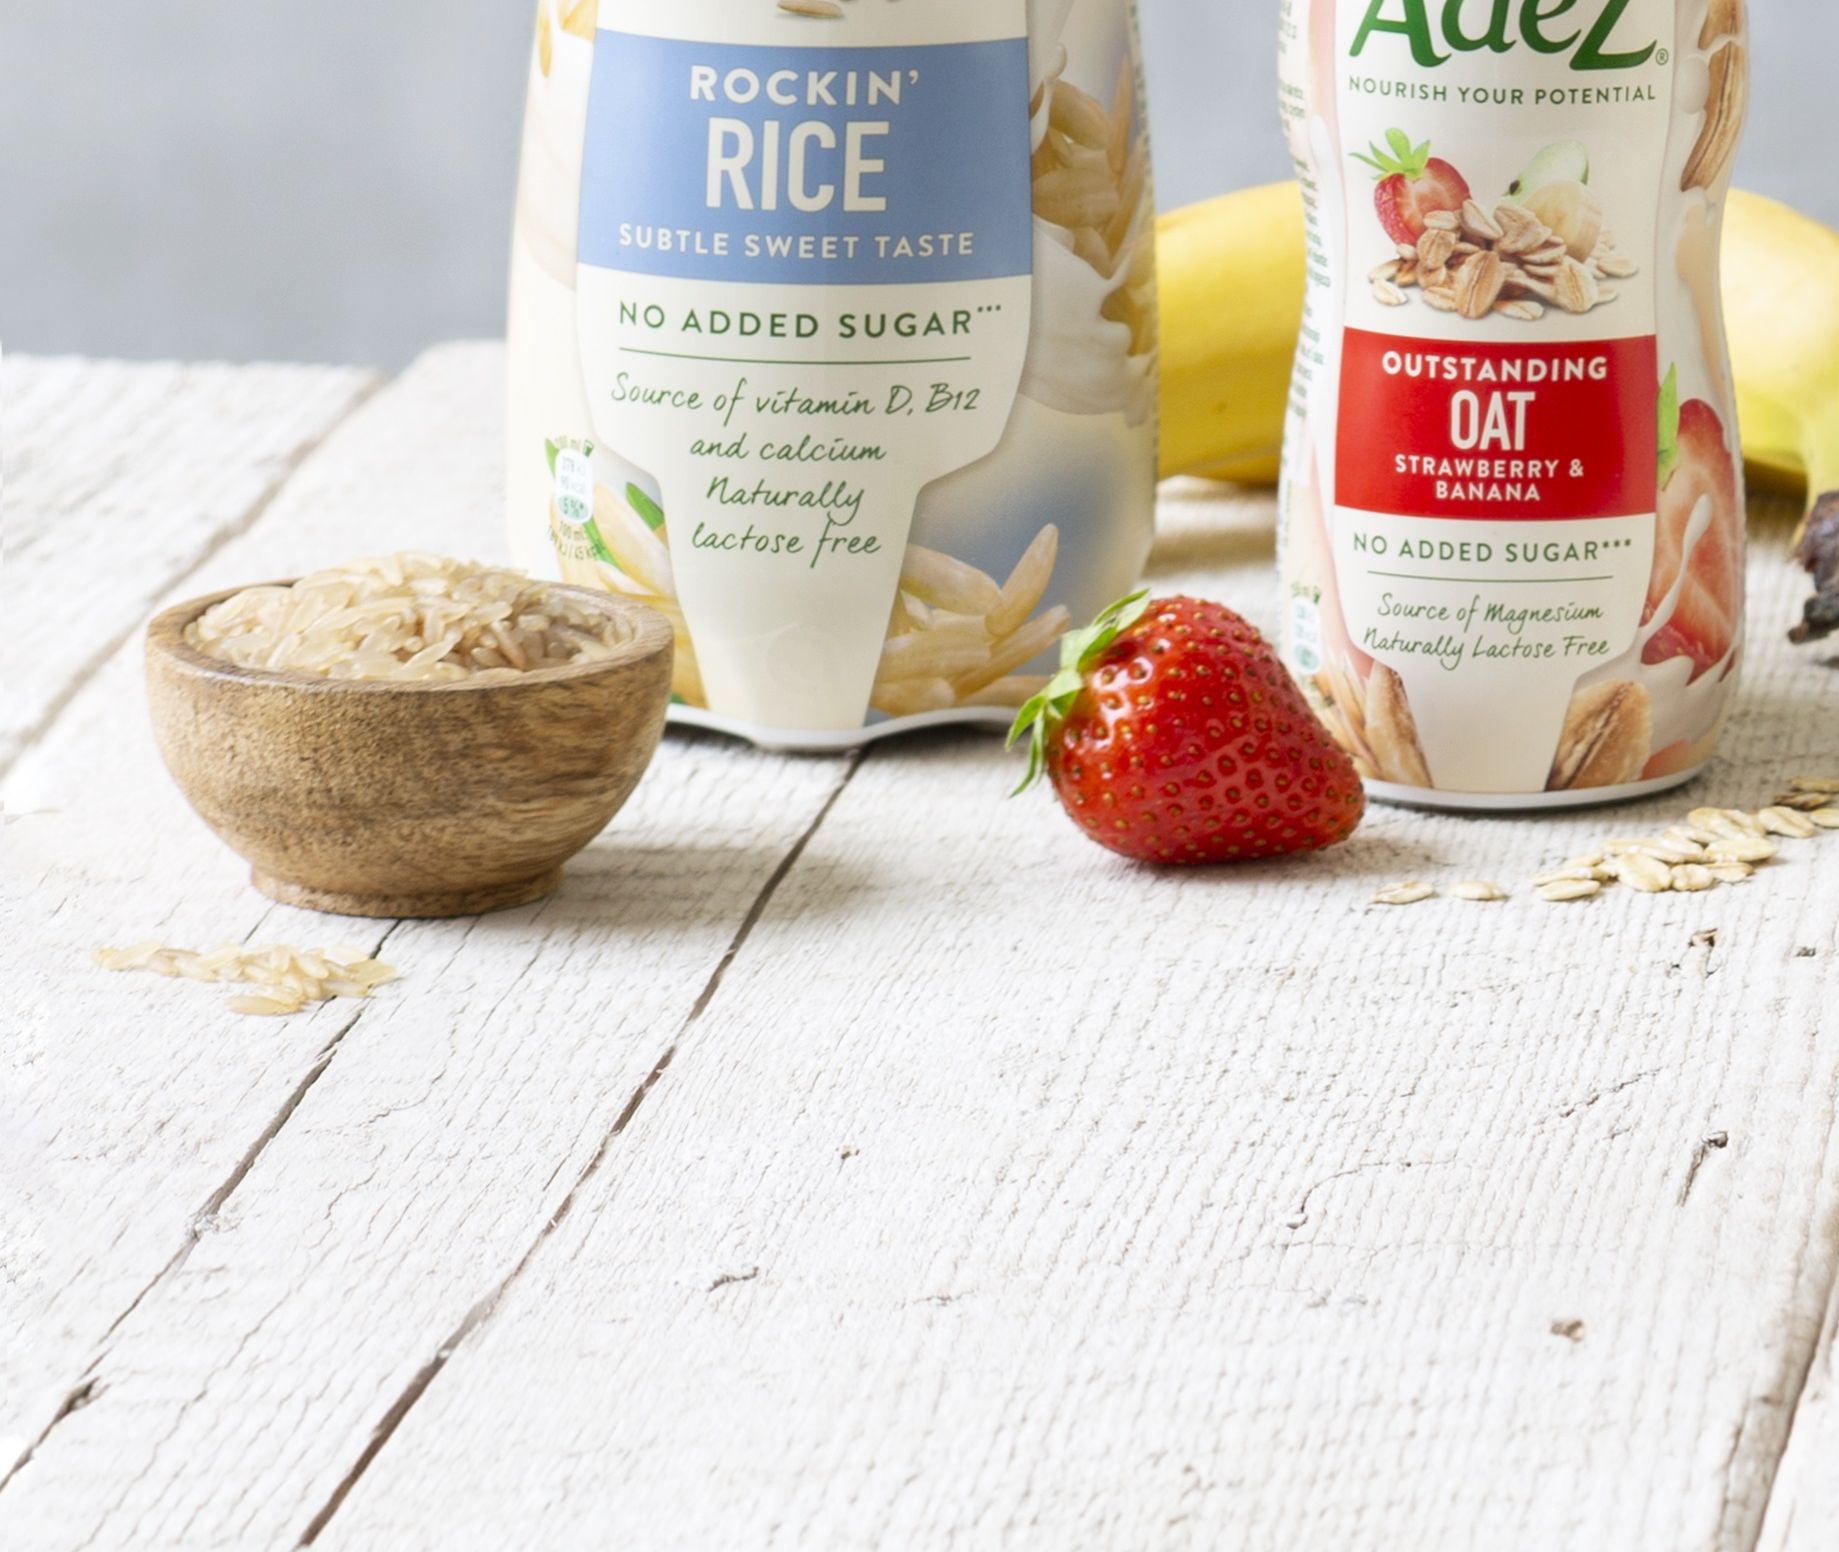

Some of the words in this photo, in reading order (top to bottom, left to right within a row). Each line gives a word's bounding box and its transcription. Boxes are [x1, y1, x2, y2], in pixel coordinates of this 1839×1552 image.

[1348, 75, 1447, 102] NOURISH
[1457, 86, 1524, 105] YOUR
[1535, 84, 1657, 105] POTENTIAL
[704, 116, 890, 213] RICE
[618, 222, 729, 256] SUBTLE
[744, 234, 859, 259] SWEET
[875, 232, 974, 258] TASTE
[619, 300, 665, 329] NO
[681, 308, 819, 339] ADDED
[1381, 350, 1608, 383] OUTSTANDING
[610, 372, 703, 411] Source
[713, 377, 745, 426] of
[755, 392, 874, 417] vitamin
[924, 381, 980, 414] B12
[1449, 389, 1535, 451] OAT
[689, 433, 749, 461] and
[759, 433, 887, 463] calcium
[1395, 454, 1559, 479] STRAWBERRY
[1568, 458, 1584, 478] &
[705, 476, 865, 527] Naturally
[1435, 480, 1541, 502] BANANA
[691, 521, 804, 553] lactose
[810, 510, 882, 569] free
[1353, 533, 1388, 556] NO
[1399, 539, 1493, 563] ADDED
[1377, 592, 1450, 622] Source
[1456, 595, 1481, 633] of
[1484, 602, 1603, 635] Magnesium
[1363, 627, 1465, 672] Naturally
[1472, 635, 1555, 659] Lactose
[1562, 636, 1609, 656] Free
